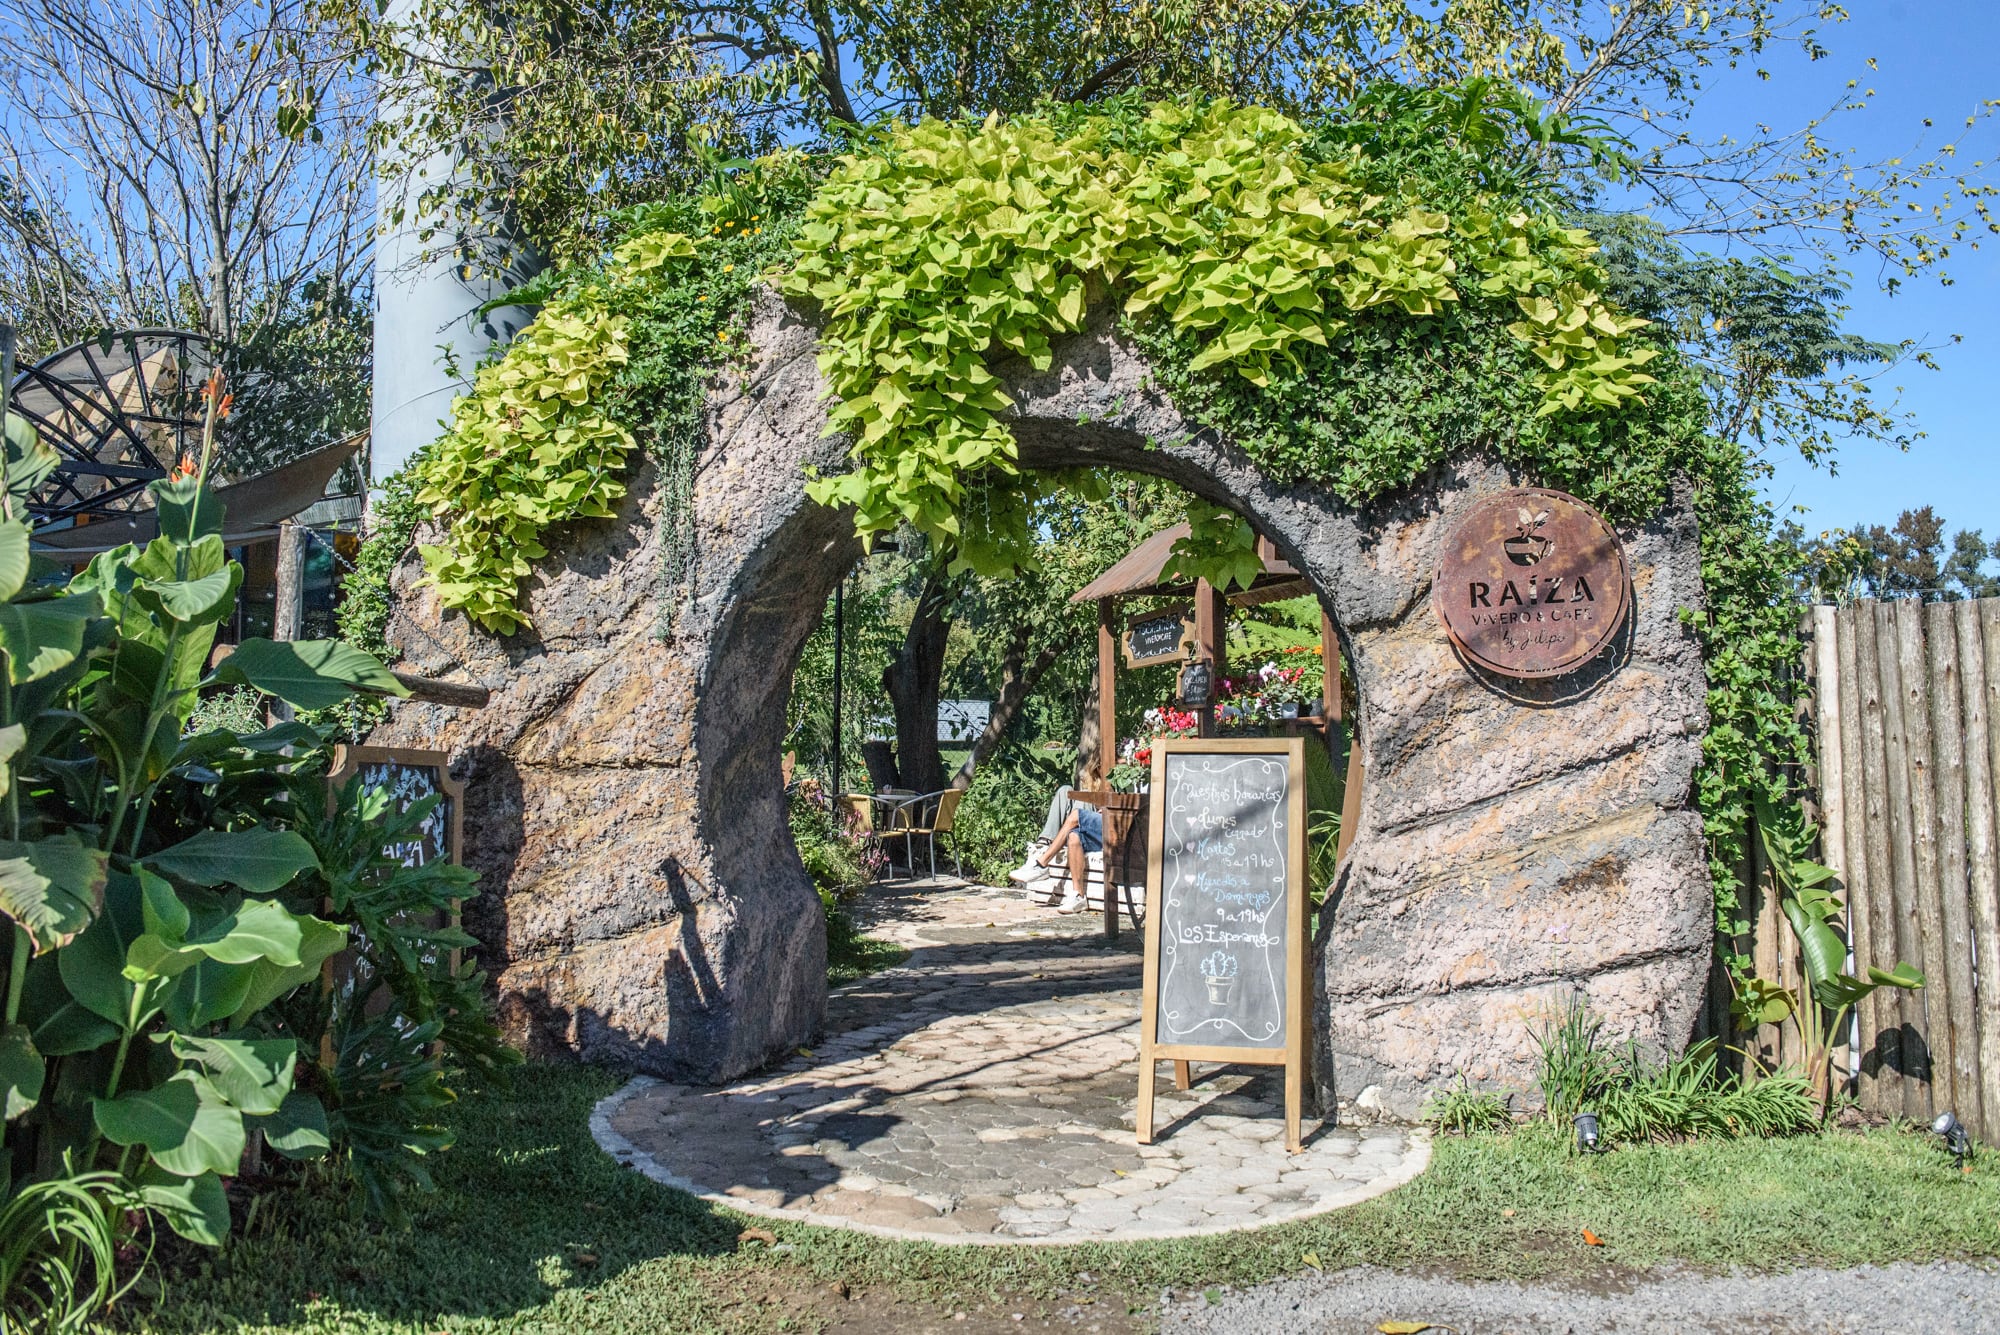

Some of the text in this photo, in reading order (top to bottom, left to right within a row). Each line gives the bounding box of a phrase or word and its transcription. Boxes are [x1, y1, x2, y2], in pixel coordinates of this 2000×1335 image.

[1472, 612, 1531, 626] VIVERO
[1536, 611, 1545, 623] &
[1181, 779, 1281, 806] Nuestros horarios
[1198, 807, 1237, 830] Lunes
[1197, 837, 1236, 861] Martes
[1243, 853, 1258, 868] 19
[1260, 853, 1275, 868] hs
[1213, 888, 1271, 911] Domingos
[1216, 908, 1225, 922] 9
[1226, 913, 1238, 922] a
